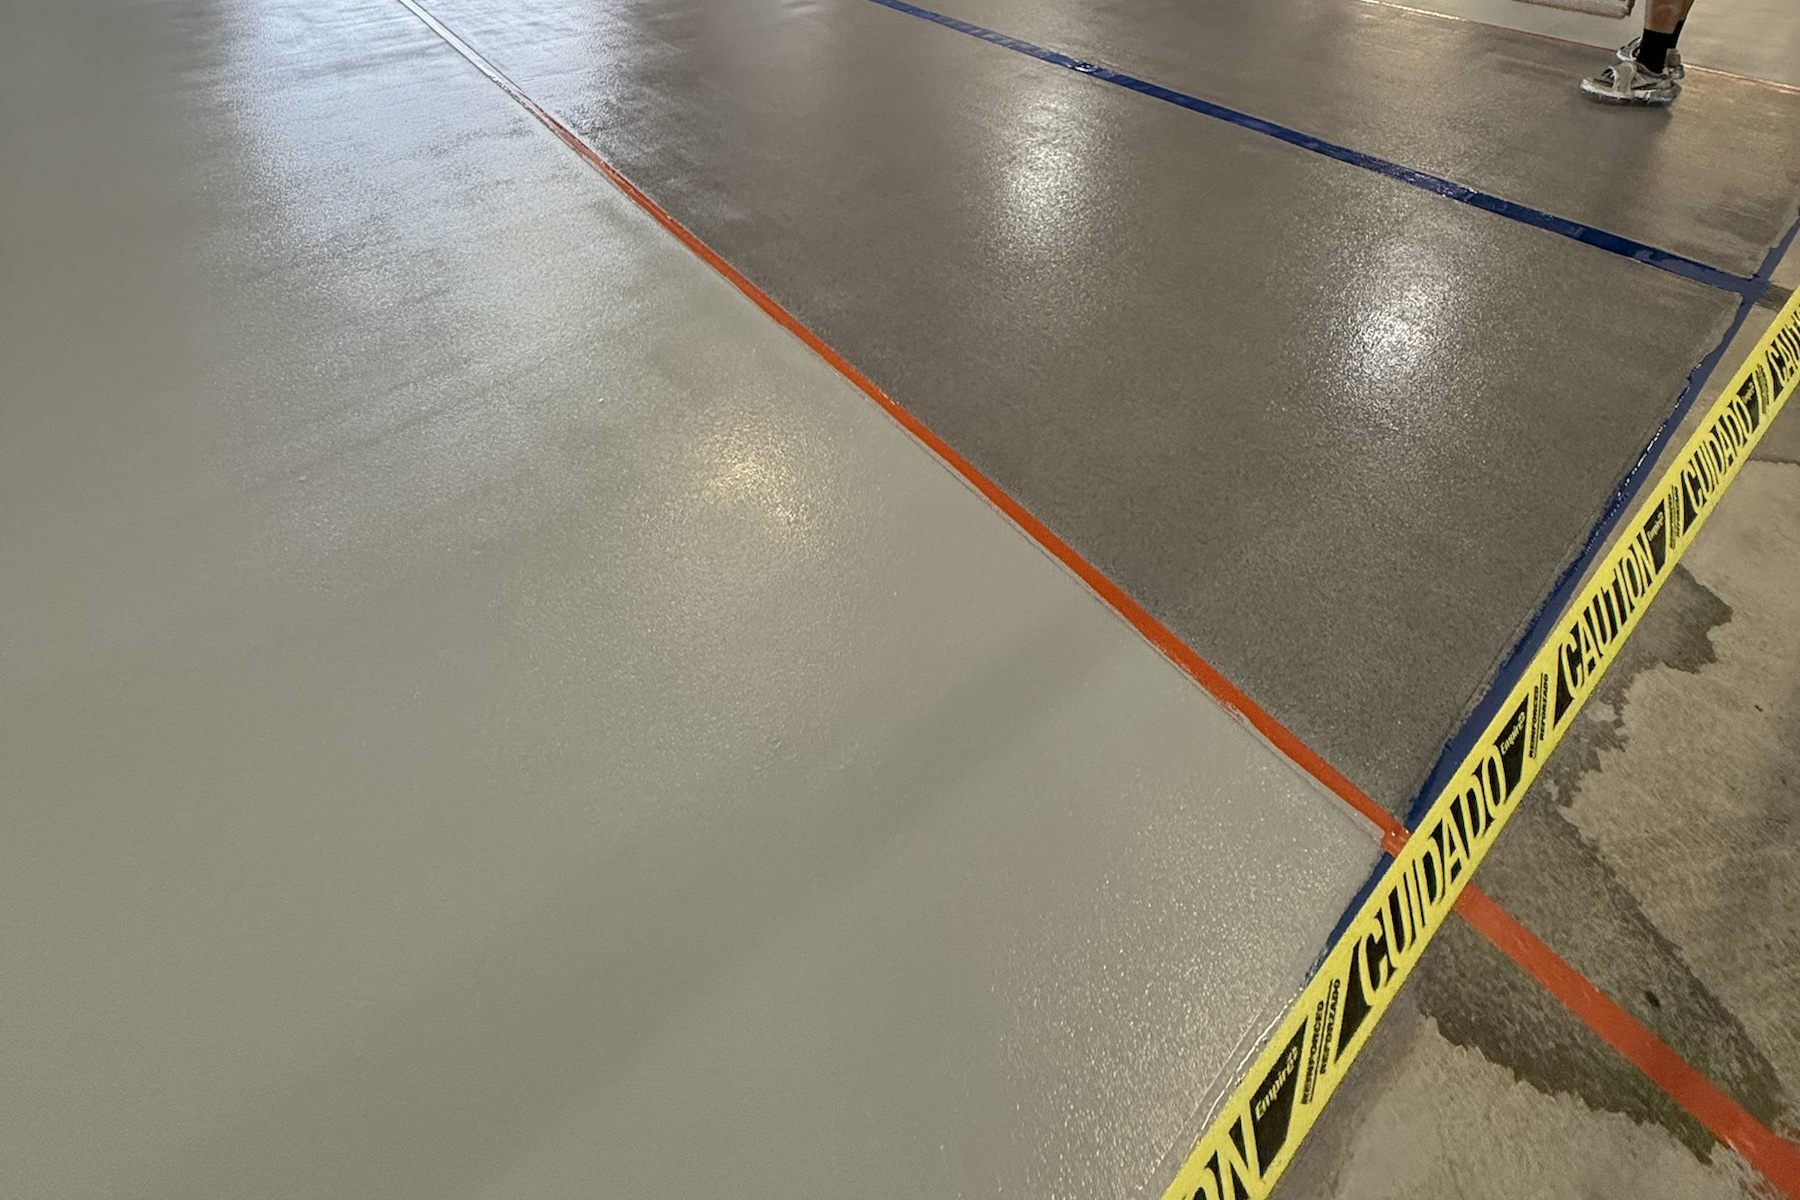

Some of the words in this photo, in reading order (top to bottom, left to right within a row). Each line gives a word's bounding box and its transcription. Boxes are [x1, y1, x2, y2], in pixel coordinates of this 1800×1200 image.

[1683, 399, 1753, 512] CUIDADO
[1561, 531, 1657, 699] CAUTION
[1357, 744, 1507, 1007] CUIDADO
[1300, 1000, 1325, 1105] REINFORCED
[1319, 978, 1341, 1075] REFORZADO
[1254, 1056, 1294, 1121] Empire
